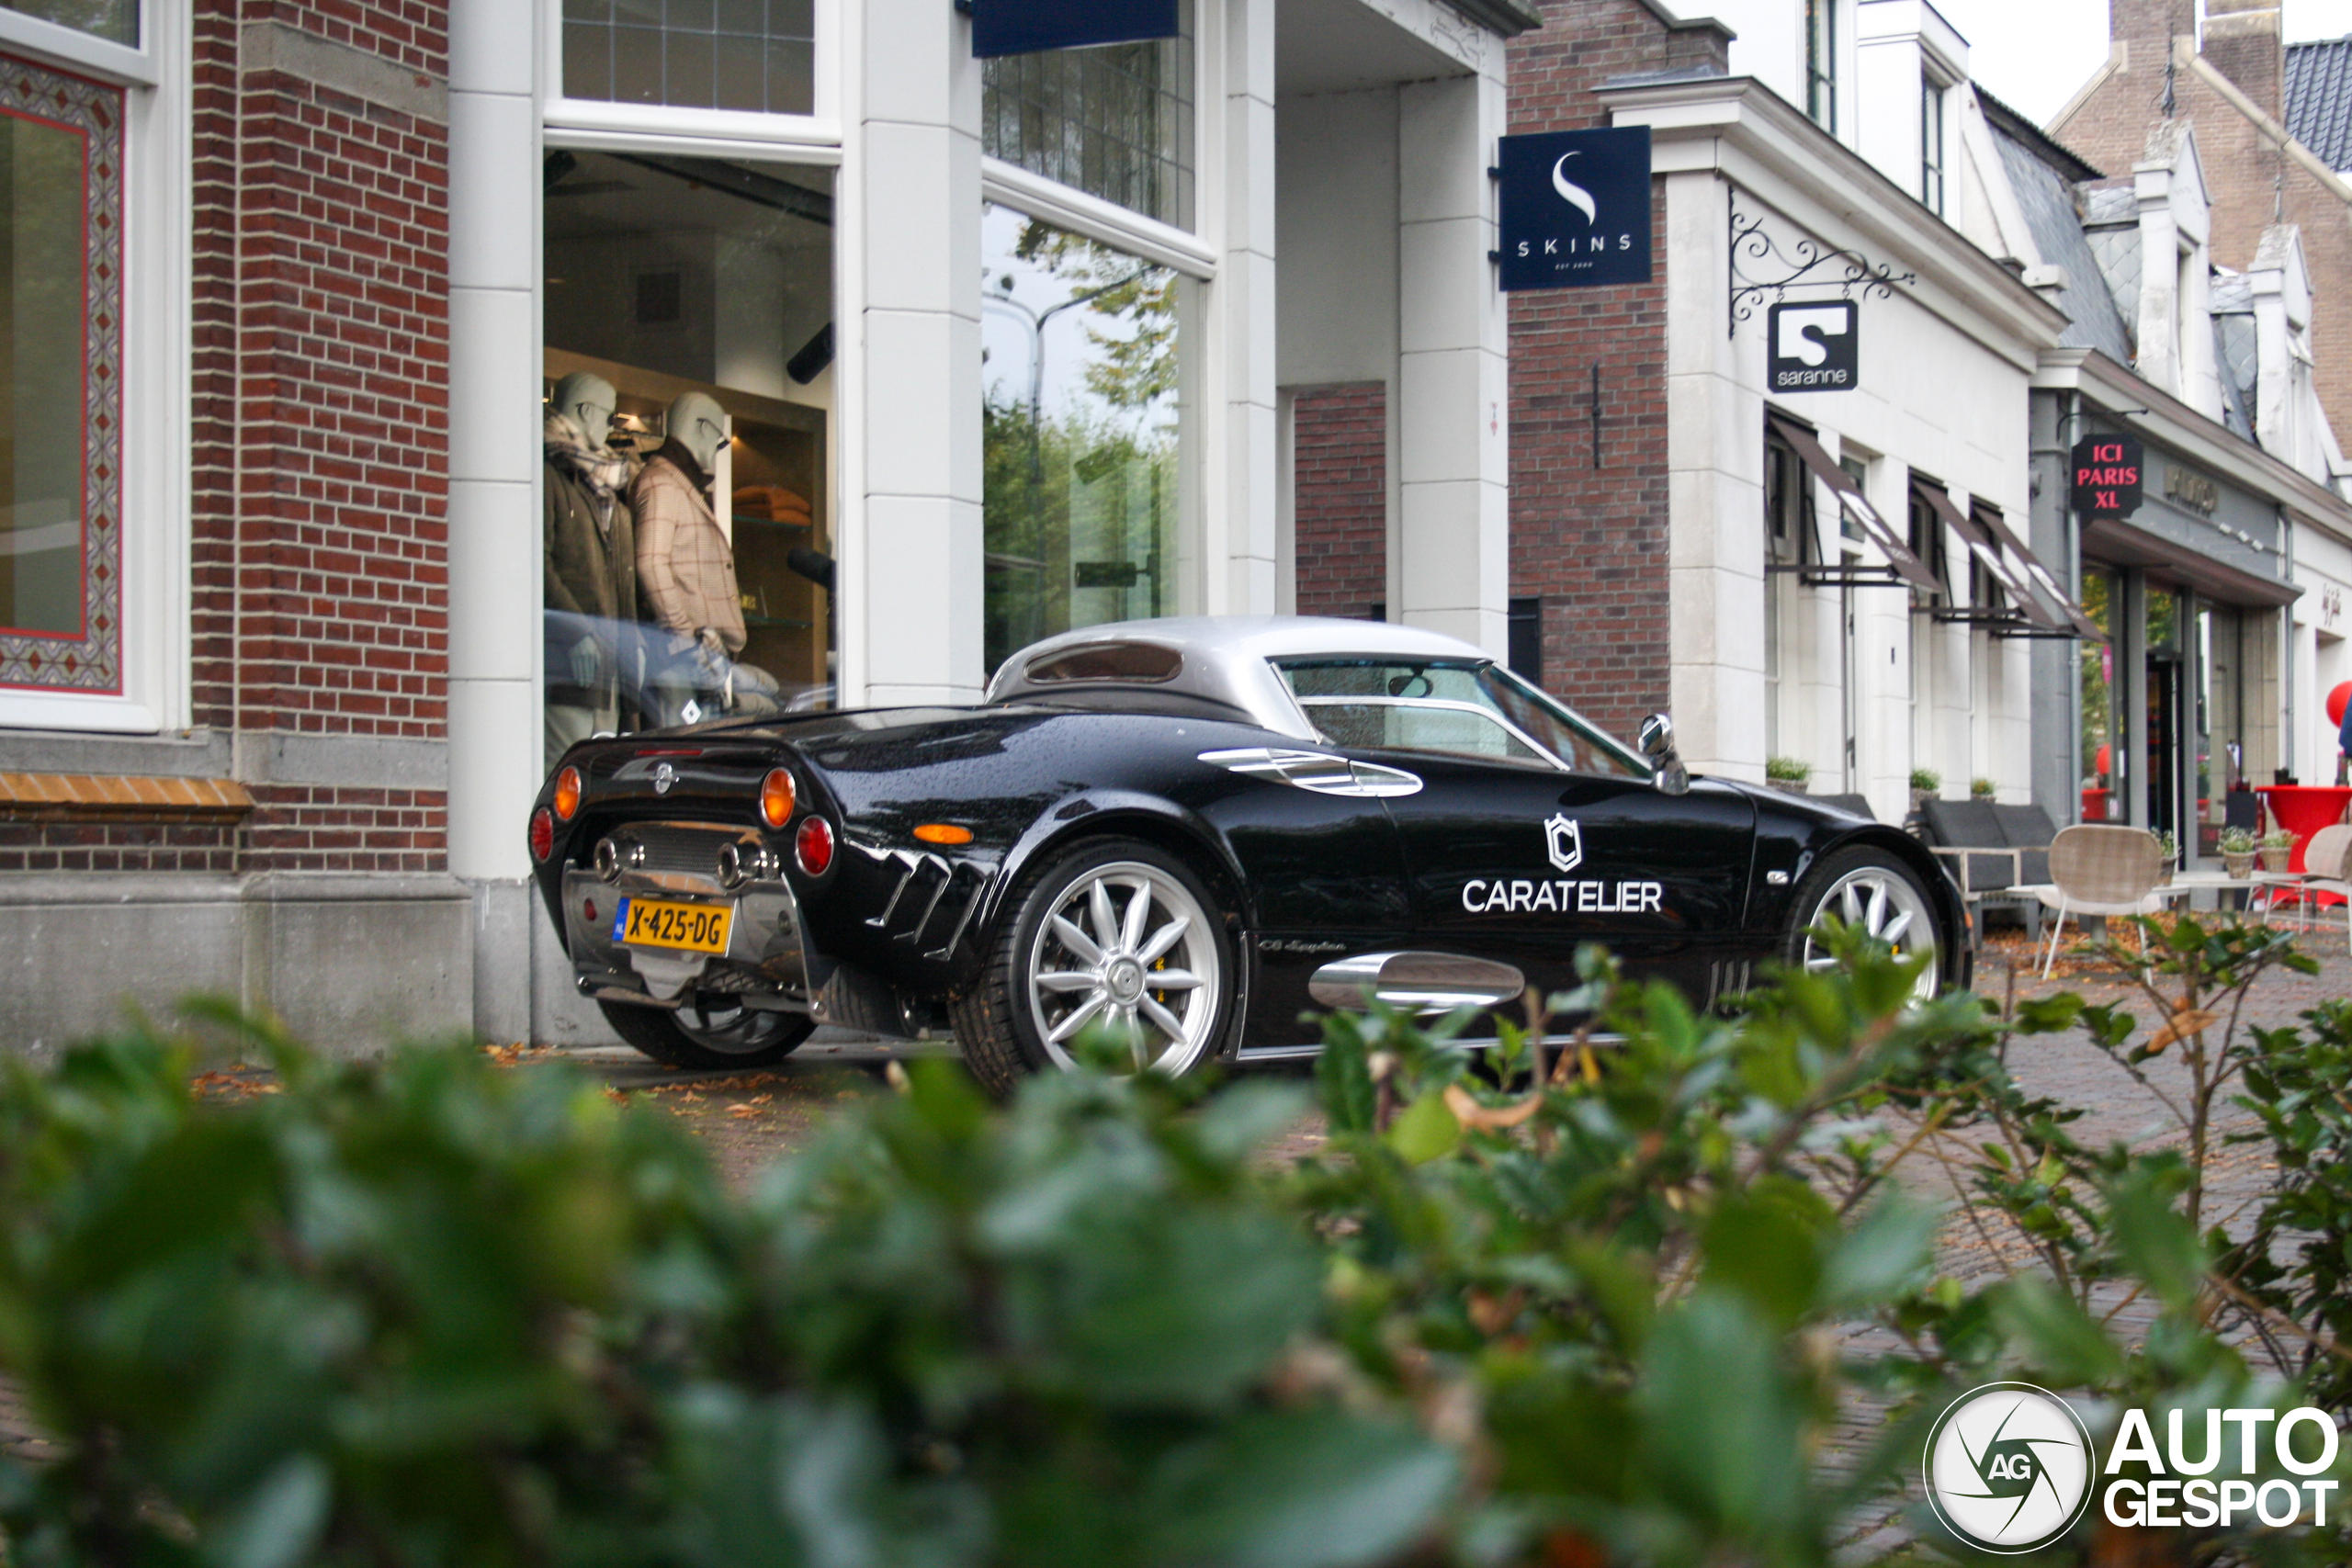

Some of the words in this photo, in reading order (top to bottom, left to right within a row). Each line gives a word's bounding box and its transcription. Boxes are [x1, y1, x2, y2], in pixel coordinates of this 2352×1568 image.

[1518, 234, 1631, 257] SKINS
[1778, 368, 1848, 386] saranne
[2093, 444, 2123, 463] ICI
[2077, 466, 2138, 487] PARIS
[2095, 491, 2120, 509] XL
[1463, 880, 1662, 912] CARATELIER
[629, 906, 722, 945] X-425-DG
